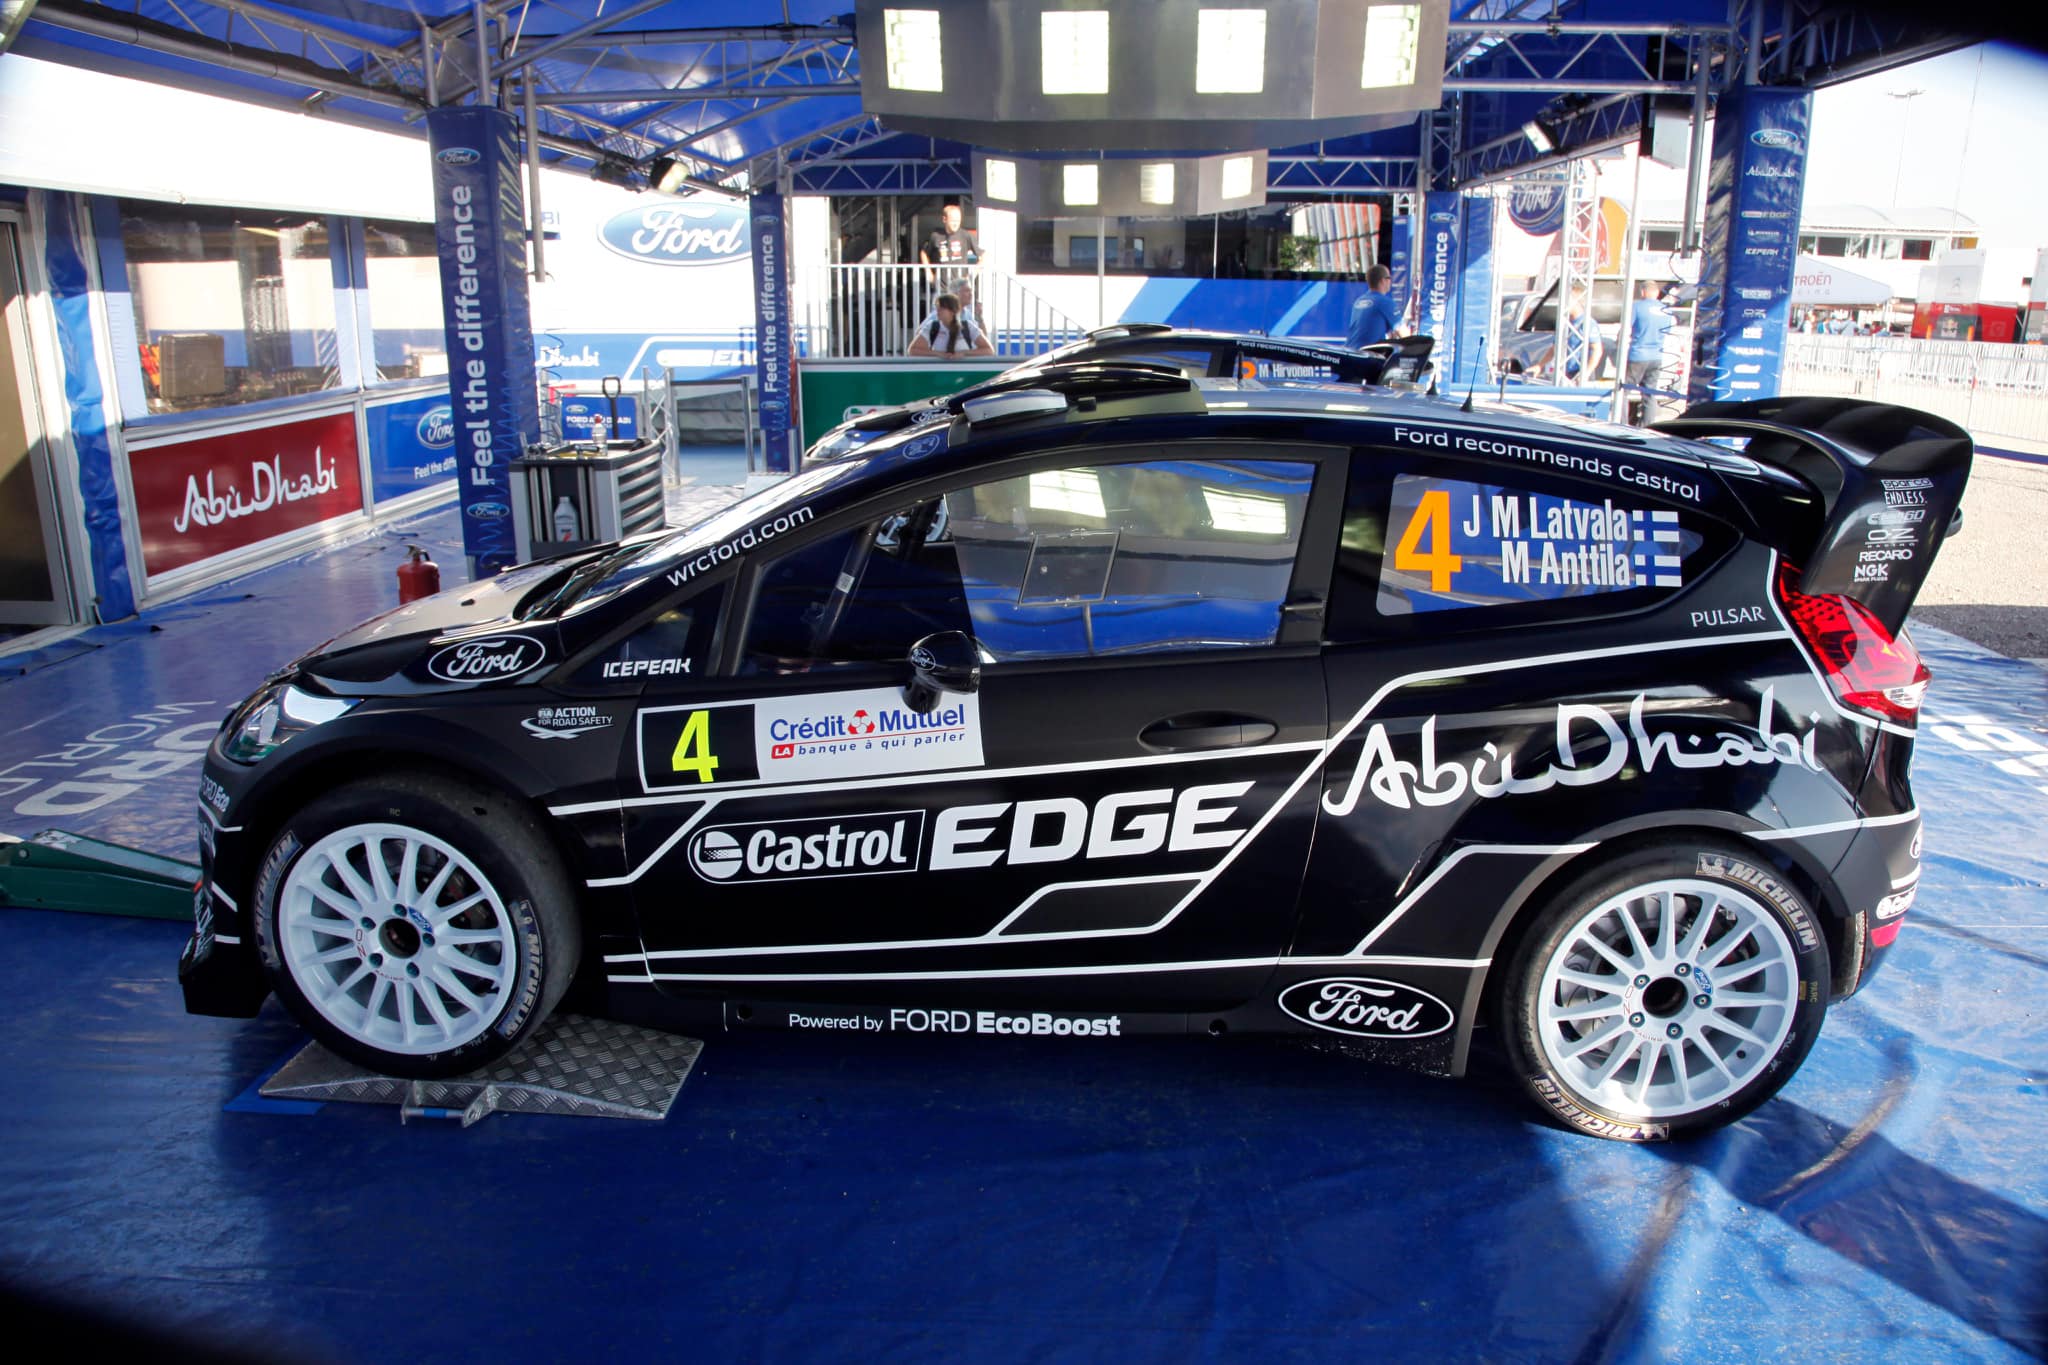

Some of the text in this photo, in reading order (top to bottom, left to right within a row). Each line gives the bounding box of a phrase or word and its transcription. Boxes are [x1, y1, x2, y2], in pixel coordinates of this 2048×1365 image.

[1759, 132, 1790, 145] Ford
[632, 205, 745, 254] Ford
[761, 234, 777, 322] difference
[1430, 231, 1449, 321] difference
[1794, 271, 1832, 286] TROËN
[453, 185, 496, 487] Feel the difference
[762, 324, 778, 354] the
[1236, 339, 1341, 364] Ford recommends Castrol
[763, 357, 779, 393] Feel
[1259, 363, 1269, 378] M
[1272, 363, 1315, 378] Hirvonen
[414, 464, 430, 480] Feel
[431, 461, 443, 474] the
[1394, 426, 1701, 502] Ford recommends Castrol
[174, 445, 339, 533] Abu Dhabi
[1882, 478, 1932, 490] sparco
[1463, 494, 1629, 542] J M Latvala
[665, 505, 815, 587] wrcford.com
[1394, 489, 1462, 593] 4
[1858, 548, 1913, 562] RECARO
[1502, 540, 1631, 587] M Anttila
[1854, 563, 1889, 578] NGK
[1690, 605, 1766, 628] PULSAR
[446, 640, 525, 677] Ford
[602, 658, 692, 678] ICEPEAK
[538, 715, 613, 727] FOR ROAD SAFETY
[554, 706, 597, 718] ACTION
[770, 703, 965, 742] Crédit Mutuel
[671, 710, 719, 783] 4
[774, 731, 965, 757] LA banque à qui parler
[1321, 714, 1541, 816] Abu
[1538, 684, 1825, 787] Dhabi
[746, 780, 1257, 873] Castrol EDGE
[1728, 861, 1818, 948] MICHELIN
[505, 933, 542, 1037] MICHELIN
[788, 1008, 1121, 1037] Powered by FORD EcoBoost
[1308, 982, 1424, 1032] Ford
[1535, 1077, 1637, 1139] MICHELIN
